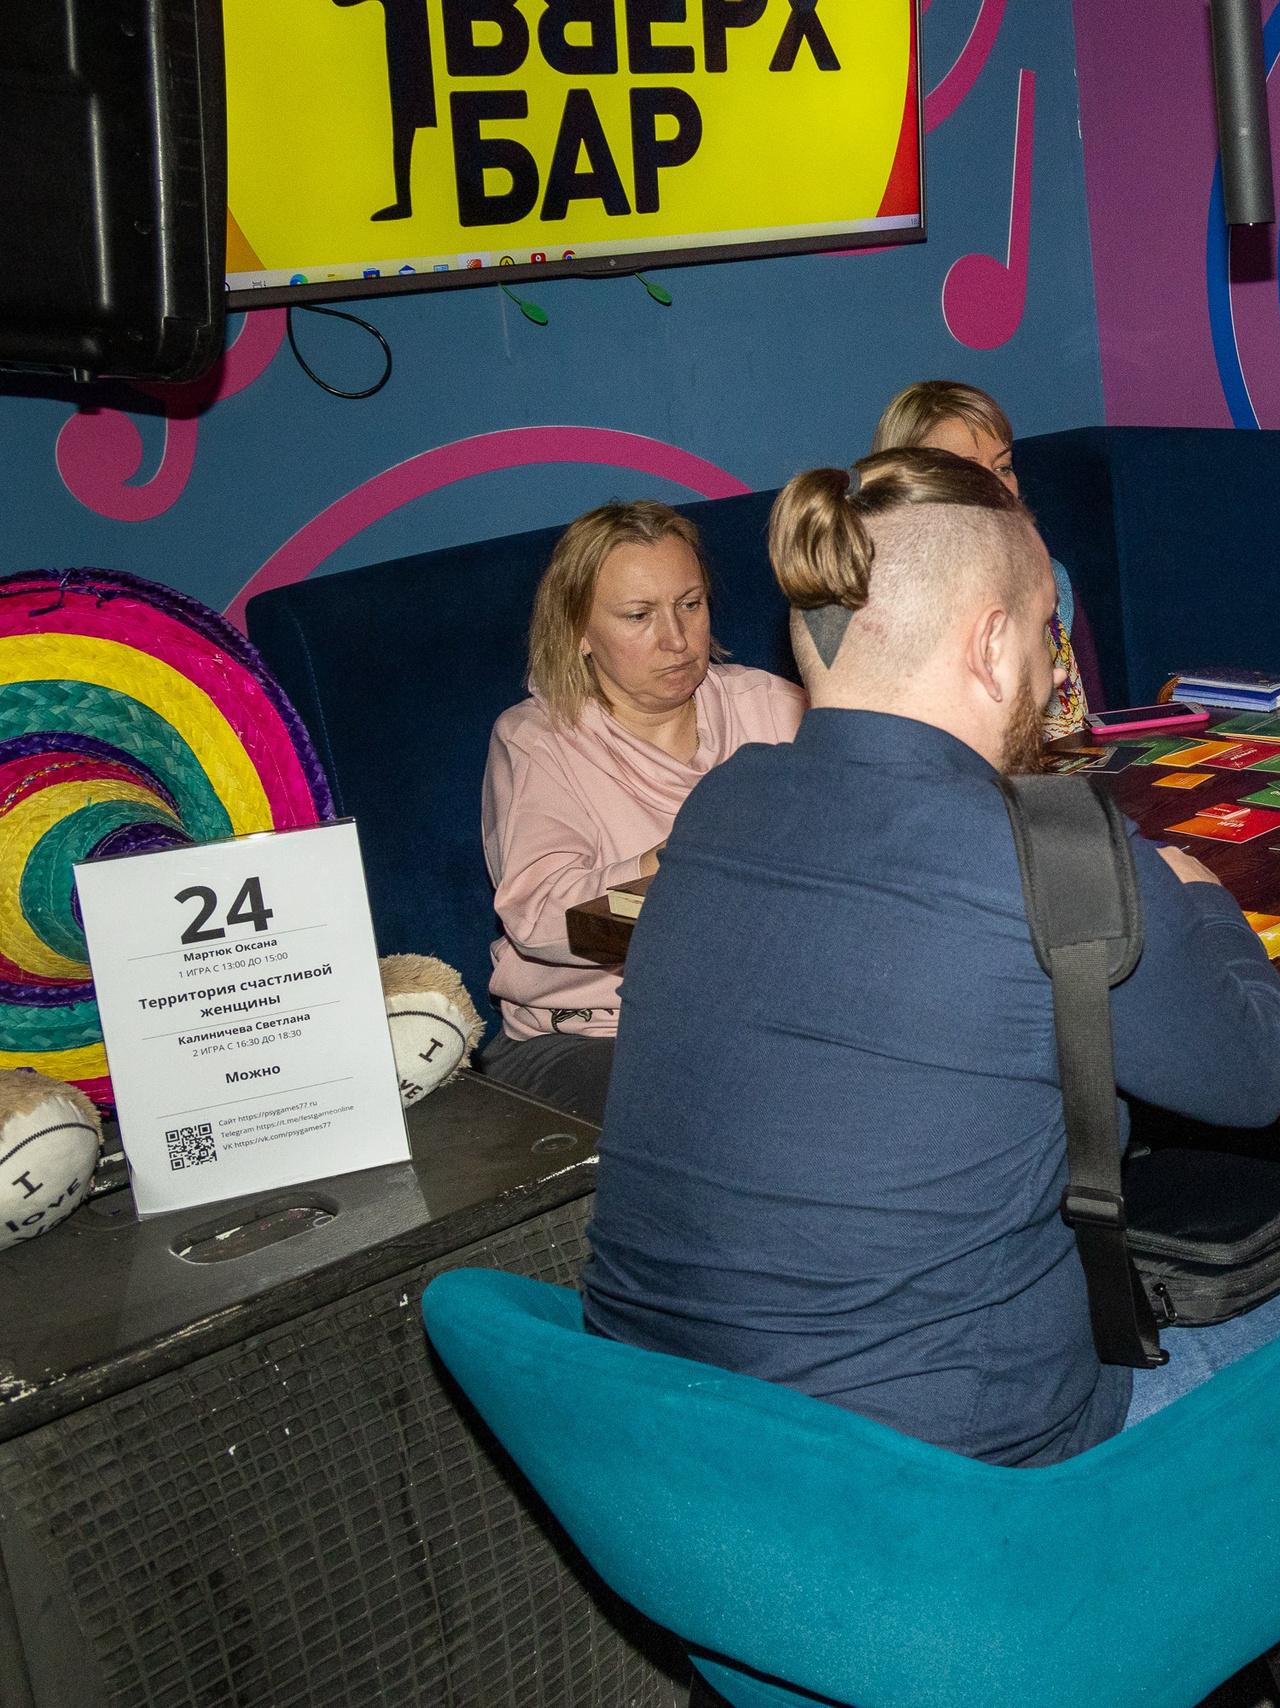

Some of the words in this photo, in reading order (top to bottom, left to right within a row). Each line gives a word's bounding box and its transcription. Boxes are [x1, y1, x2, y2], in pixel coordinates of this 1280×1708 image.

[449, 86, 703, 228] БАР
[173, 876, 274, 945] 24
[183, 946, 233, 963] Мартюк
[235, 938, 278, 954] Оксана
[179, 970, 184, 979] 1
[186, 966, 212, 978] ИГРА
[213, 964, 220, 973] С
[222, 959, 246, 971] 13:00
[247, 957, 262, 968] ДО
[264, 952, 289, 963] 15:00
[138, 984, 236, 1011] Территория
[240, 963, 333, 991] счастливой
[200, 995, 281, 1018] женщины
[178, 1023, 253, 1046] Калиничева
[255, 1012, 311, 1030] Светлана
[192, 1049, 199, 1058] 2
[200, 1044, 226, 1056] ИГРА
[227, 1042, 234, 1051] С
[236, 1037, 260, 1049] 16:30
[261, 1034, 276, 1045] ДО
[278, 1029, 302, 1040] 18:30
[418, 1037, 444, 1063] I
[225, 1063, 281, 1085] Можно
[218, 1117, 237, 1127] Сайт
[221, 1126, 255, 1139] Telegram
[222, 1142, 233, 1151] VK
[12, 1170, 44, 1200] I
